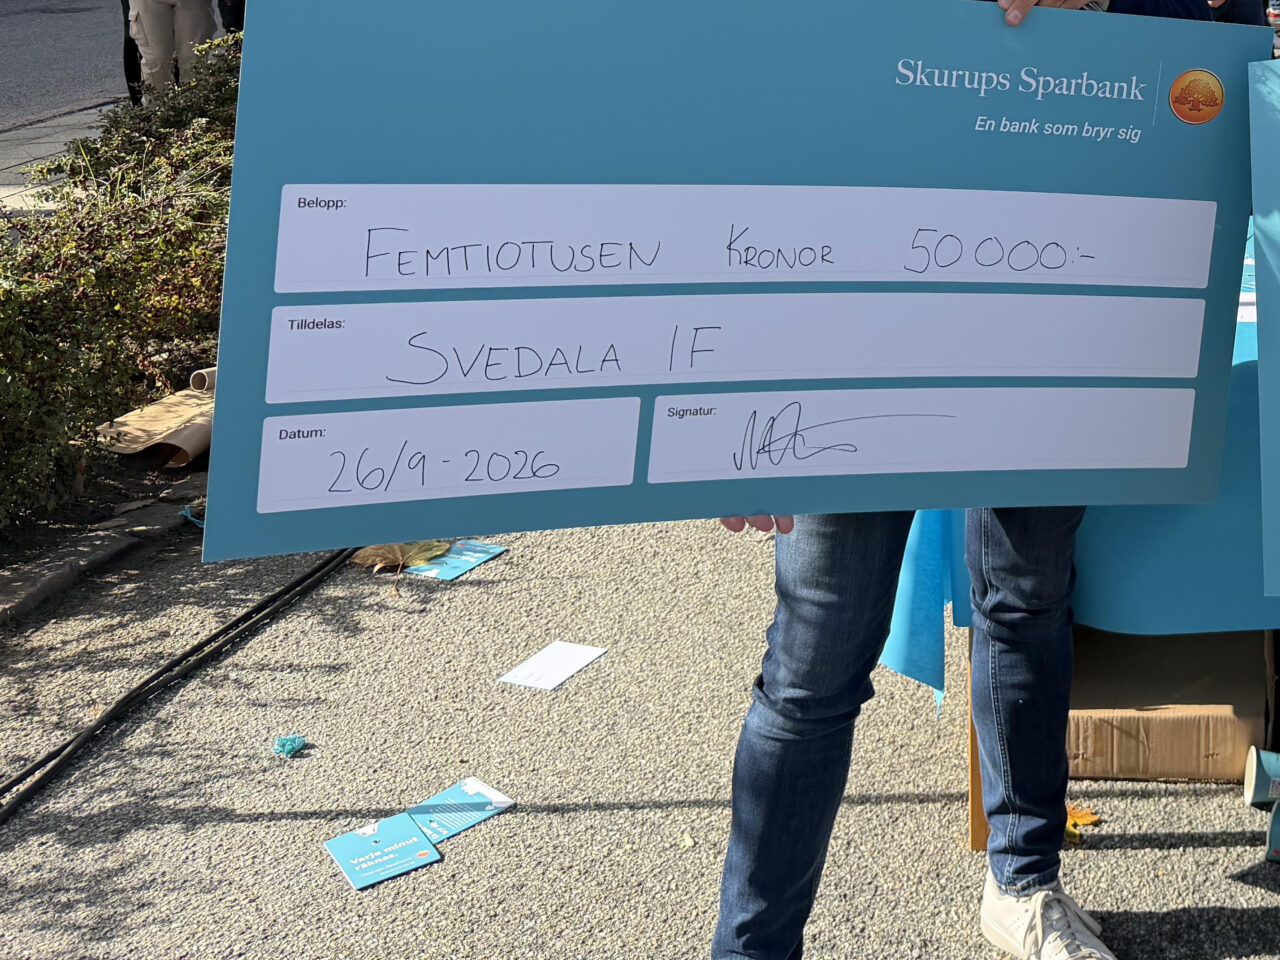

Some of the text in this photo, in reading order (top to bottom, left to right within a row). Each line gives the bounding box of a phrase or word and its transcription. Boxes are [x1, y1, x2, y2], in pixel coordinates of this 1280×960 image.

[895, 58, 1147, 101] Skurups Sparbank
[974, 116, 1142, 144] En bank som bryr sig
[297, 196, 348, 210] Belopp:
[365, 227, 661, 277] FEMTIOTUSEN
[726, 224, 836, 269] KRONOR
[287, 318, 346, 330] Tilldelas:
[385, 325, 722, 385] SVEDALA IF
[666, 406, 717, 419] Signatur:
[278, 427, 326, 440] Datum:
